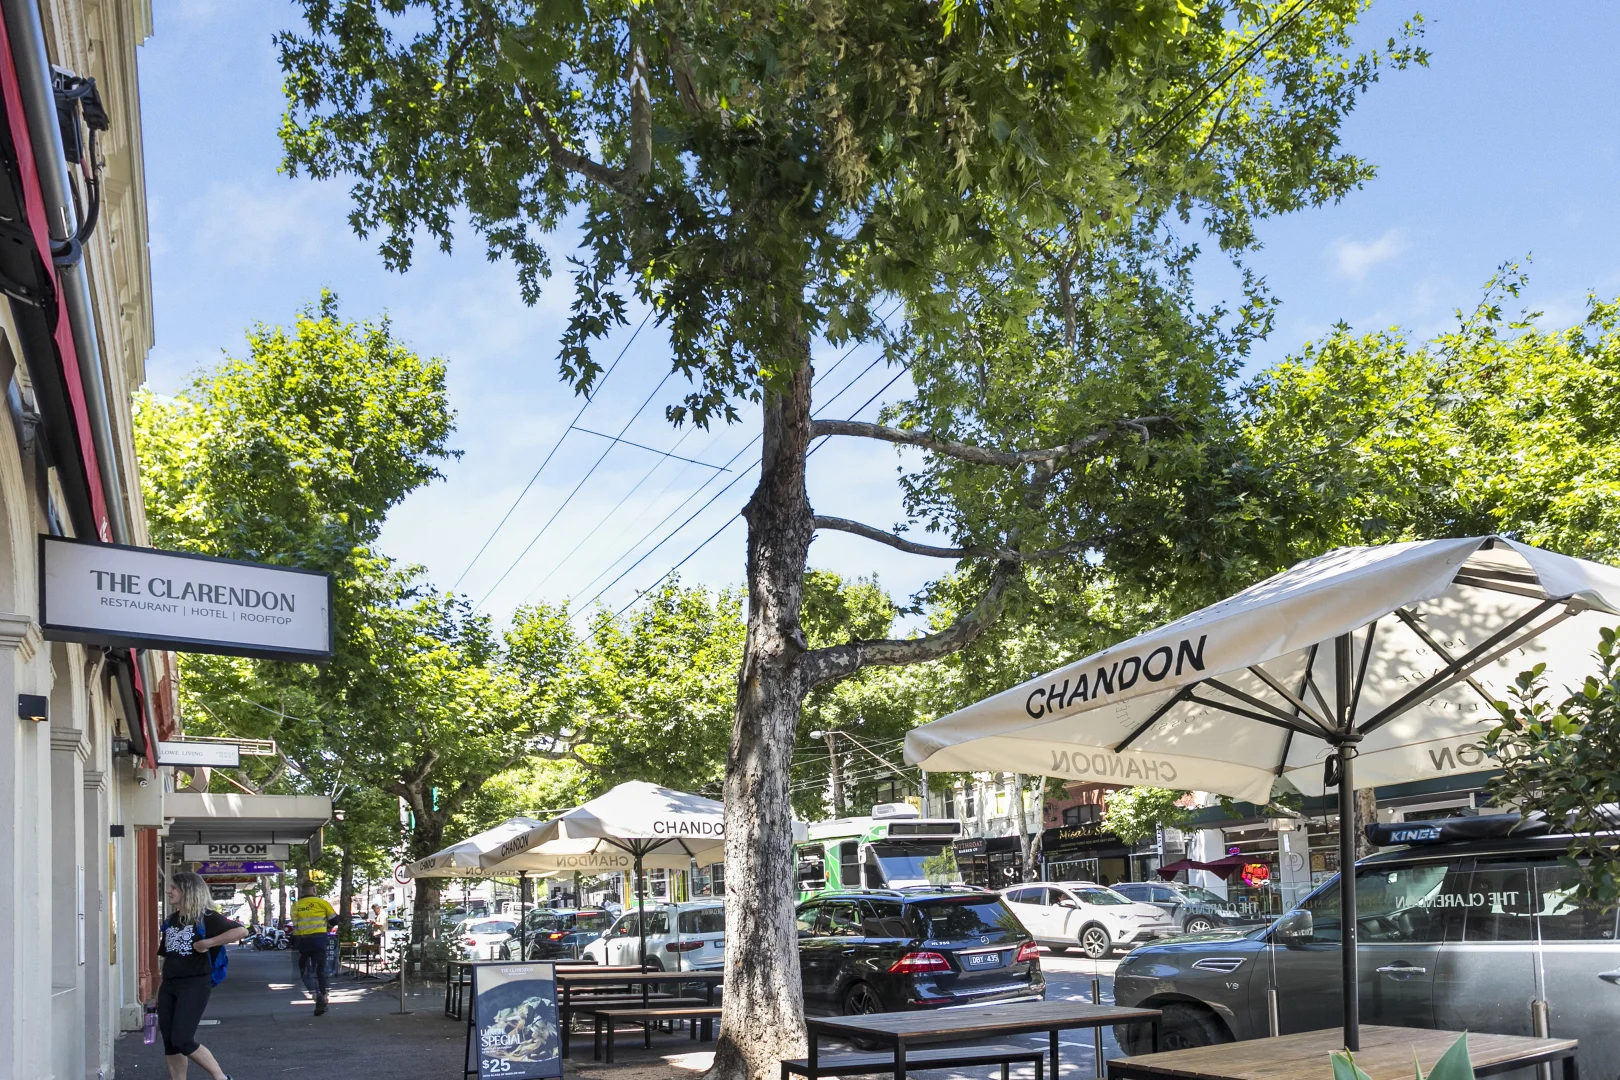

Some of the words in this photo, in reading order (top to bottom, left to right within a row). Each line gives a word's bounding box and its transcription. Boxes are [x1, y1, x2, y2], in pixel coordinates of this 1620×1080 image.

[89, 569, 141, 595] THE
[147, 577, 296, 613] CLARENDON
[100, 596, 179, 614] RESTAURANT
[191, 607, 229, 620] HOTEL
[240, 612, 292, 626] ROOFTOP
[1026, 634, 1208, 720] CHANDON
[653, 820, 725, 836] CHANDO
[1390, 827, 1443, 842] KINGS
[244, 844, 267, 854] OM
[501, 834, 530, 857] CHANDON
[1225, 982, 1240, 990] V8
[481, 1033, 521, 1047] SPECIAL
[482, 1058, 511, 1073] $25
